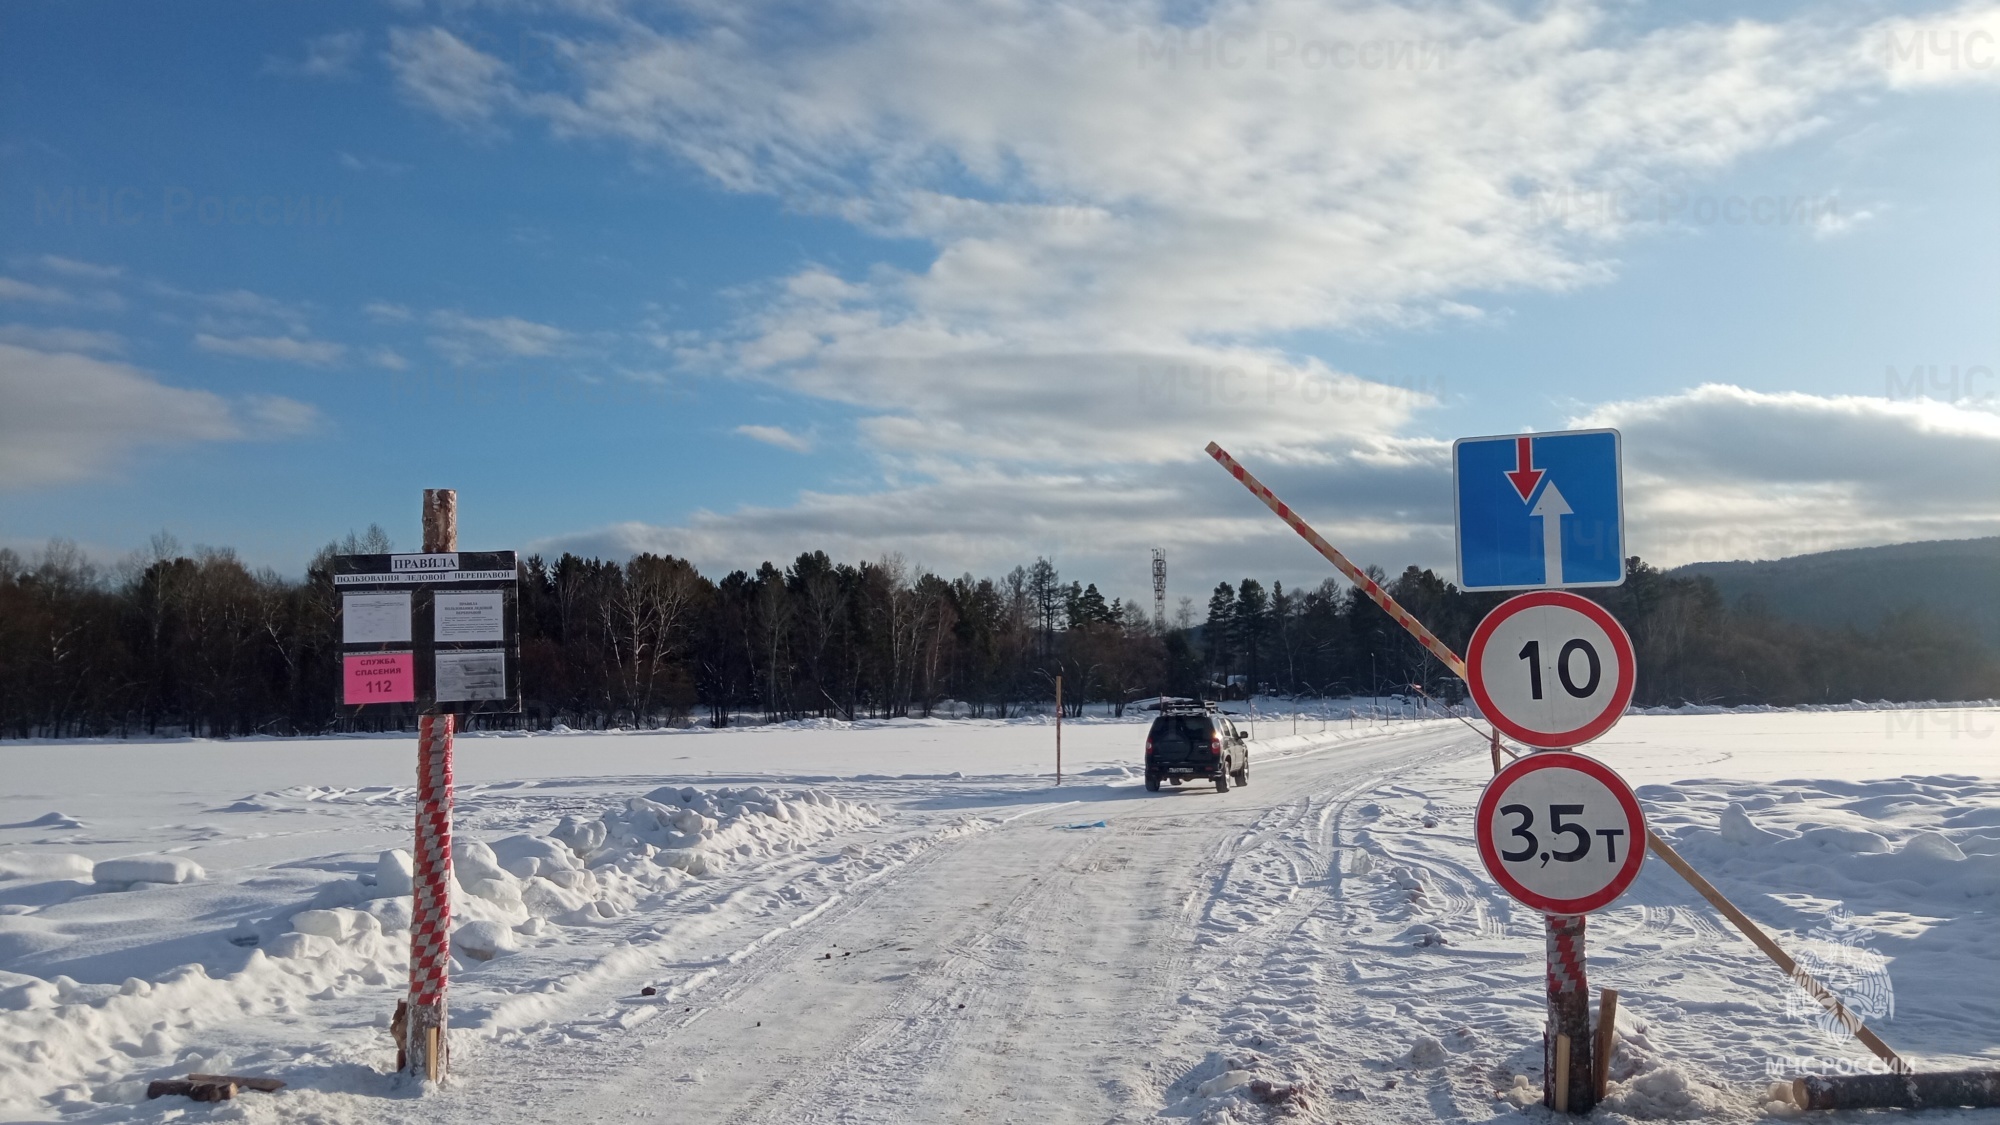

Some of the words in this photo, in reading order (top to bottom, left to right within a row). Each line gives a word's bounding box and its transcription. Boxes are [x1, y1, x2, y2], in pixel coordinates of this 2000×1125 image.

[336, 574, 400, 583] ПОЛЬЗОВАНИЯ
[405, 572, 446, 581] ЛЕДОВОЙ
[454, 570, 510, 579] ПЕРЕПРАВОЙ
[360, 658, 396, 666] СЛУЖБА
[1518, 638, 1601, 699] 10
[355, 668, 402, 676] СПАСЕНИЯ
[366, 680, 392, 693] 112
